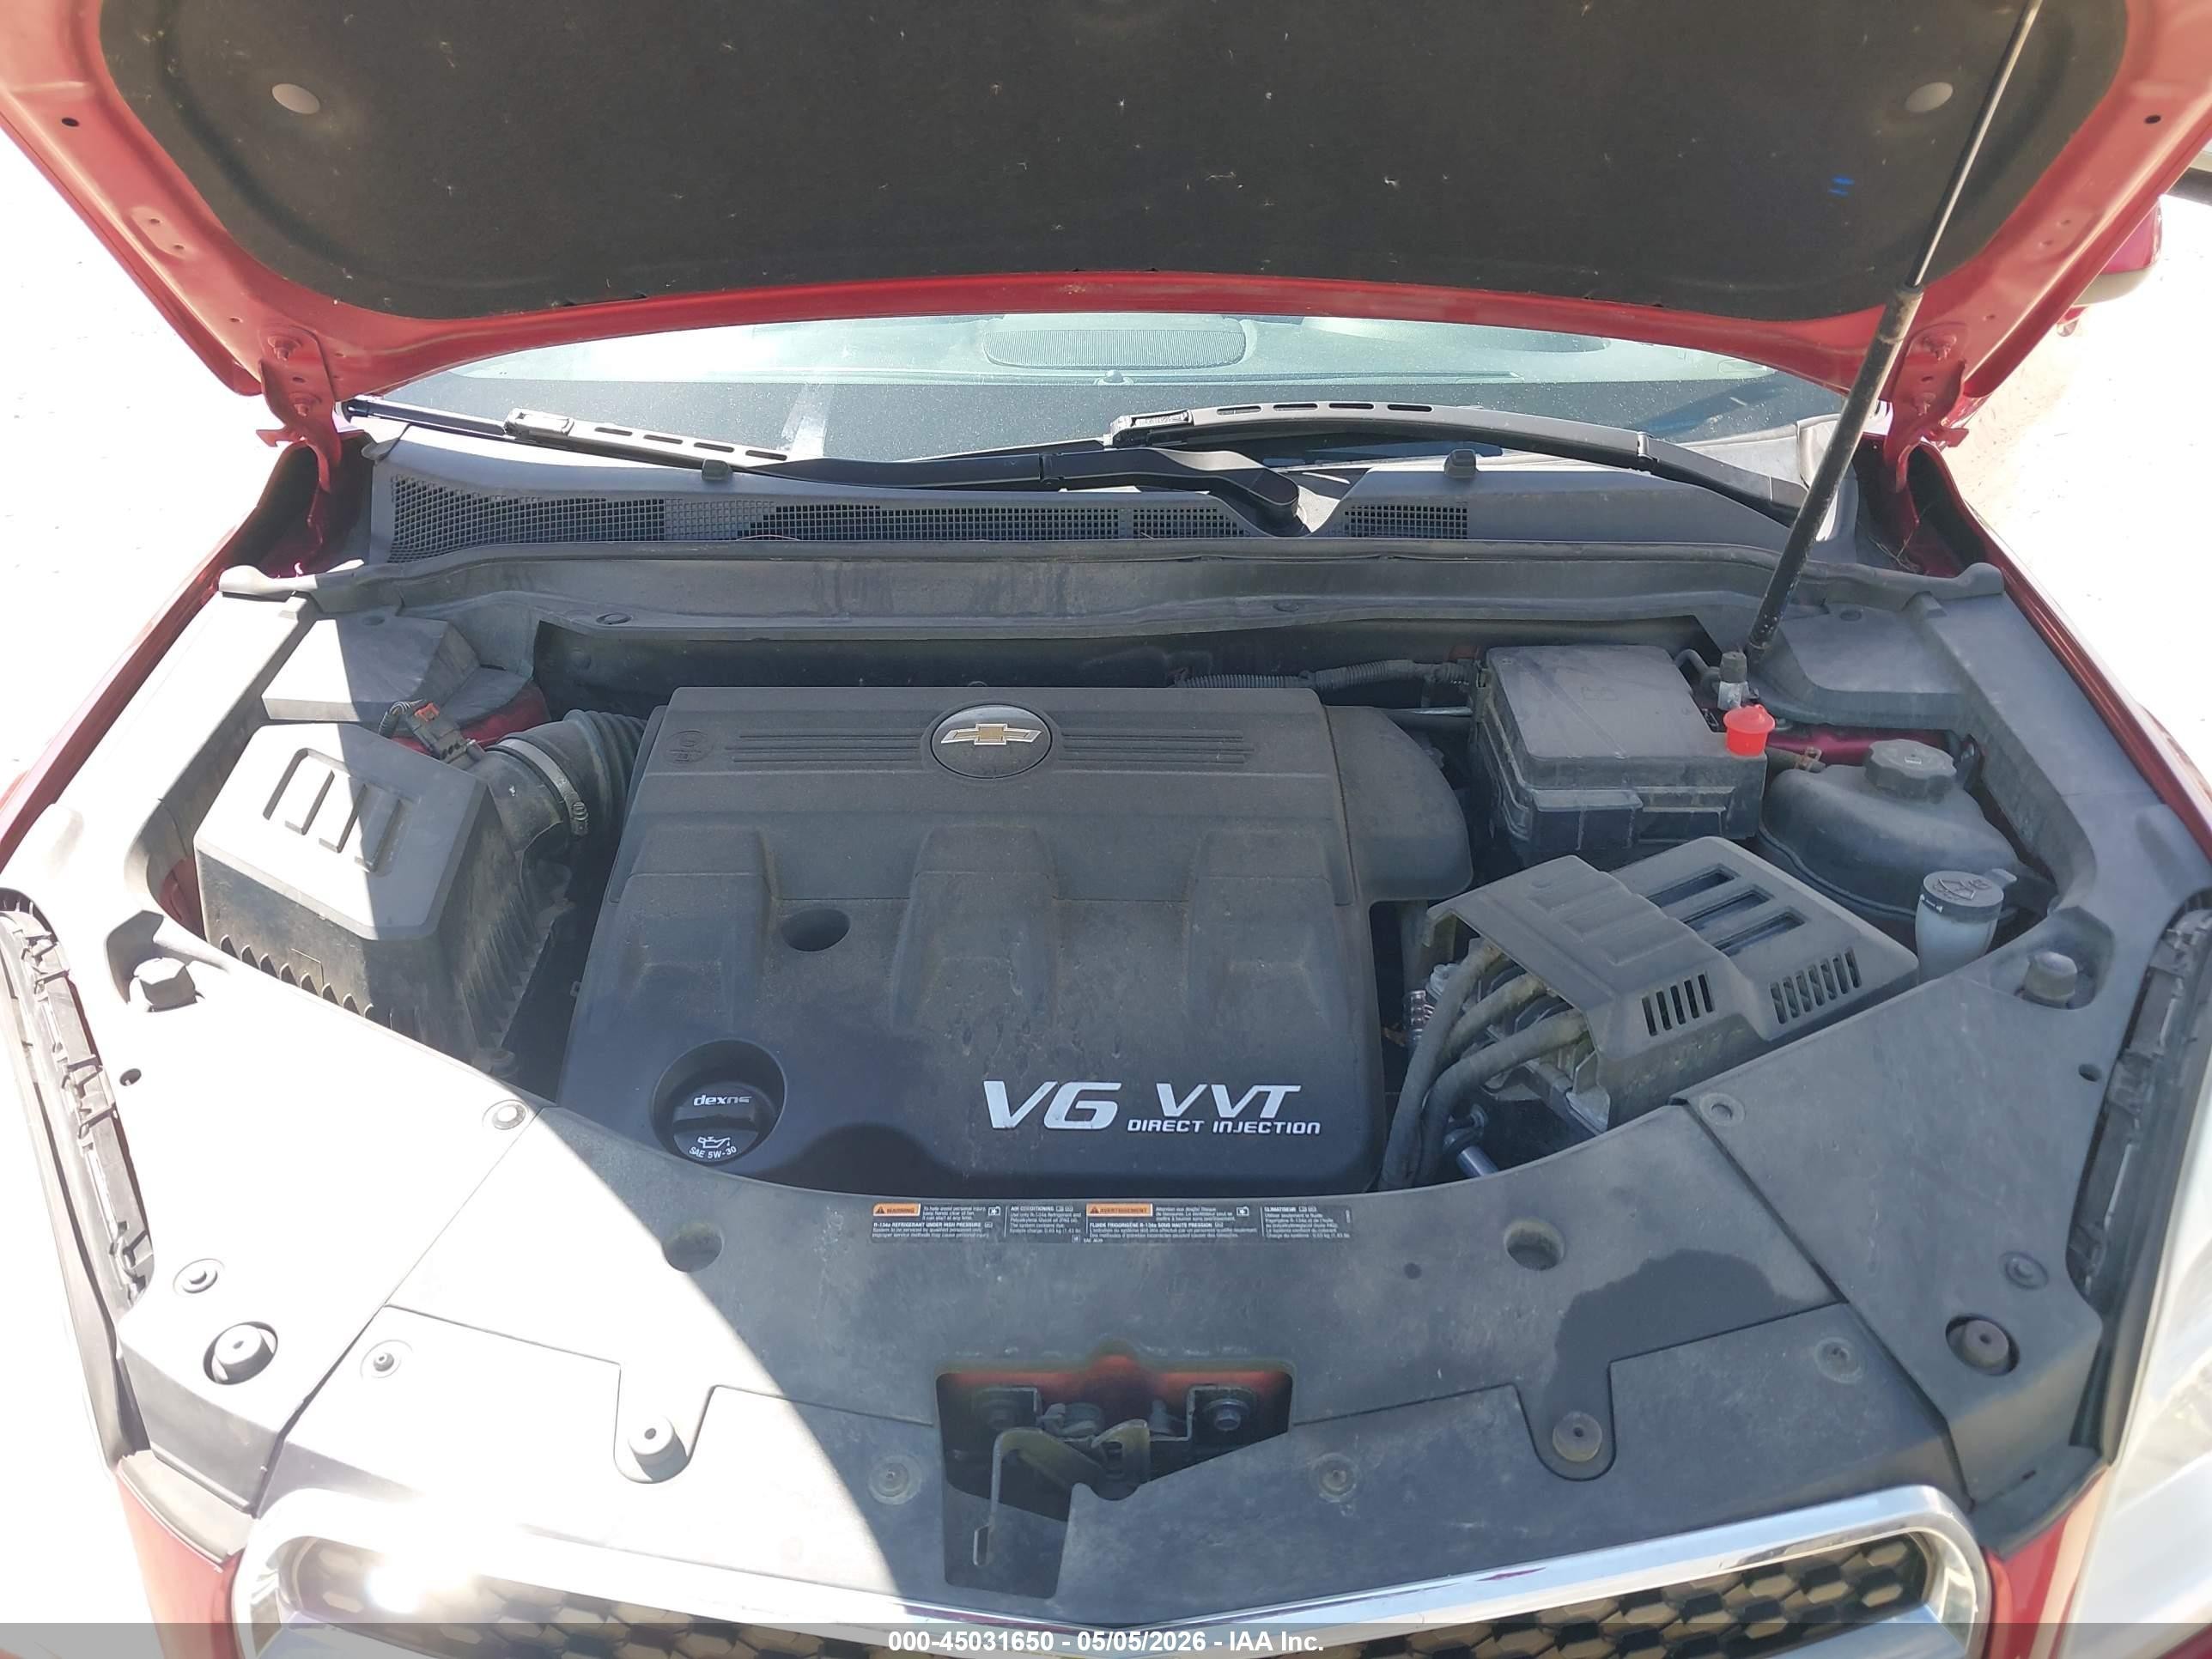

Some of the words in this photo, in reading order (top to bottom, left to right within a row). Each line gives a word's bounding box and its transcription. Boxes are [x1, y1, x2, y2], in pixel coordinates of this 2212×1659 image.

[983, 1080, 1121, 1130] V6
[1156, 1083, 1301, 1119] VVT
[1127, 1120, 1204, 1133] DIRECT
[1212, 1121, 1321, 1134] INJECTION
[690, 1146, 705, 1158] SAE
[708, 1146, 737, 1158] 5W-30
